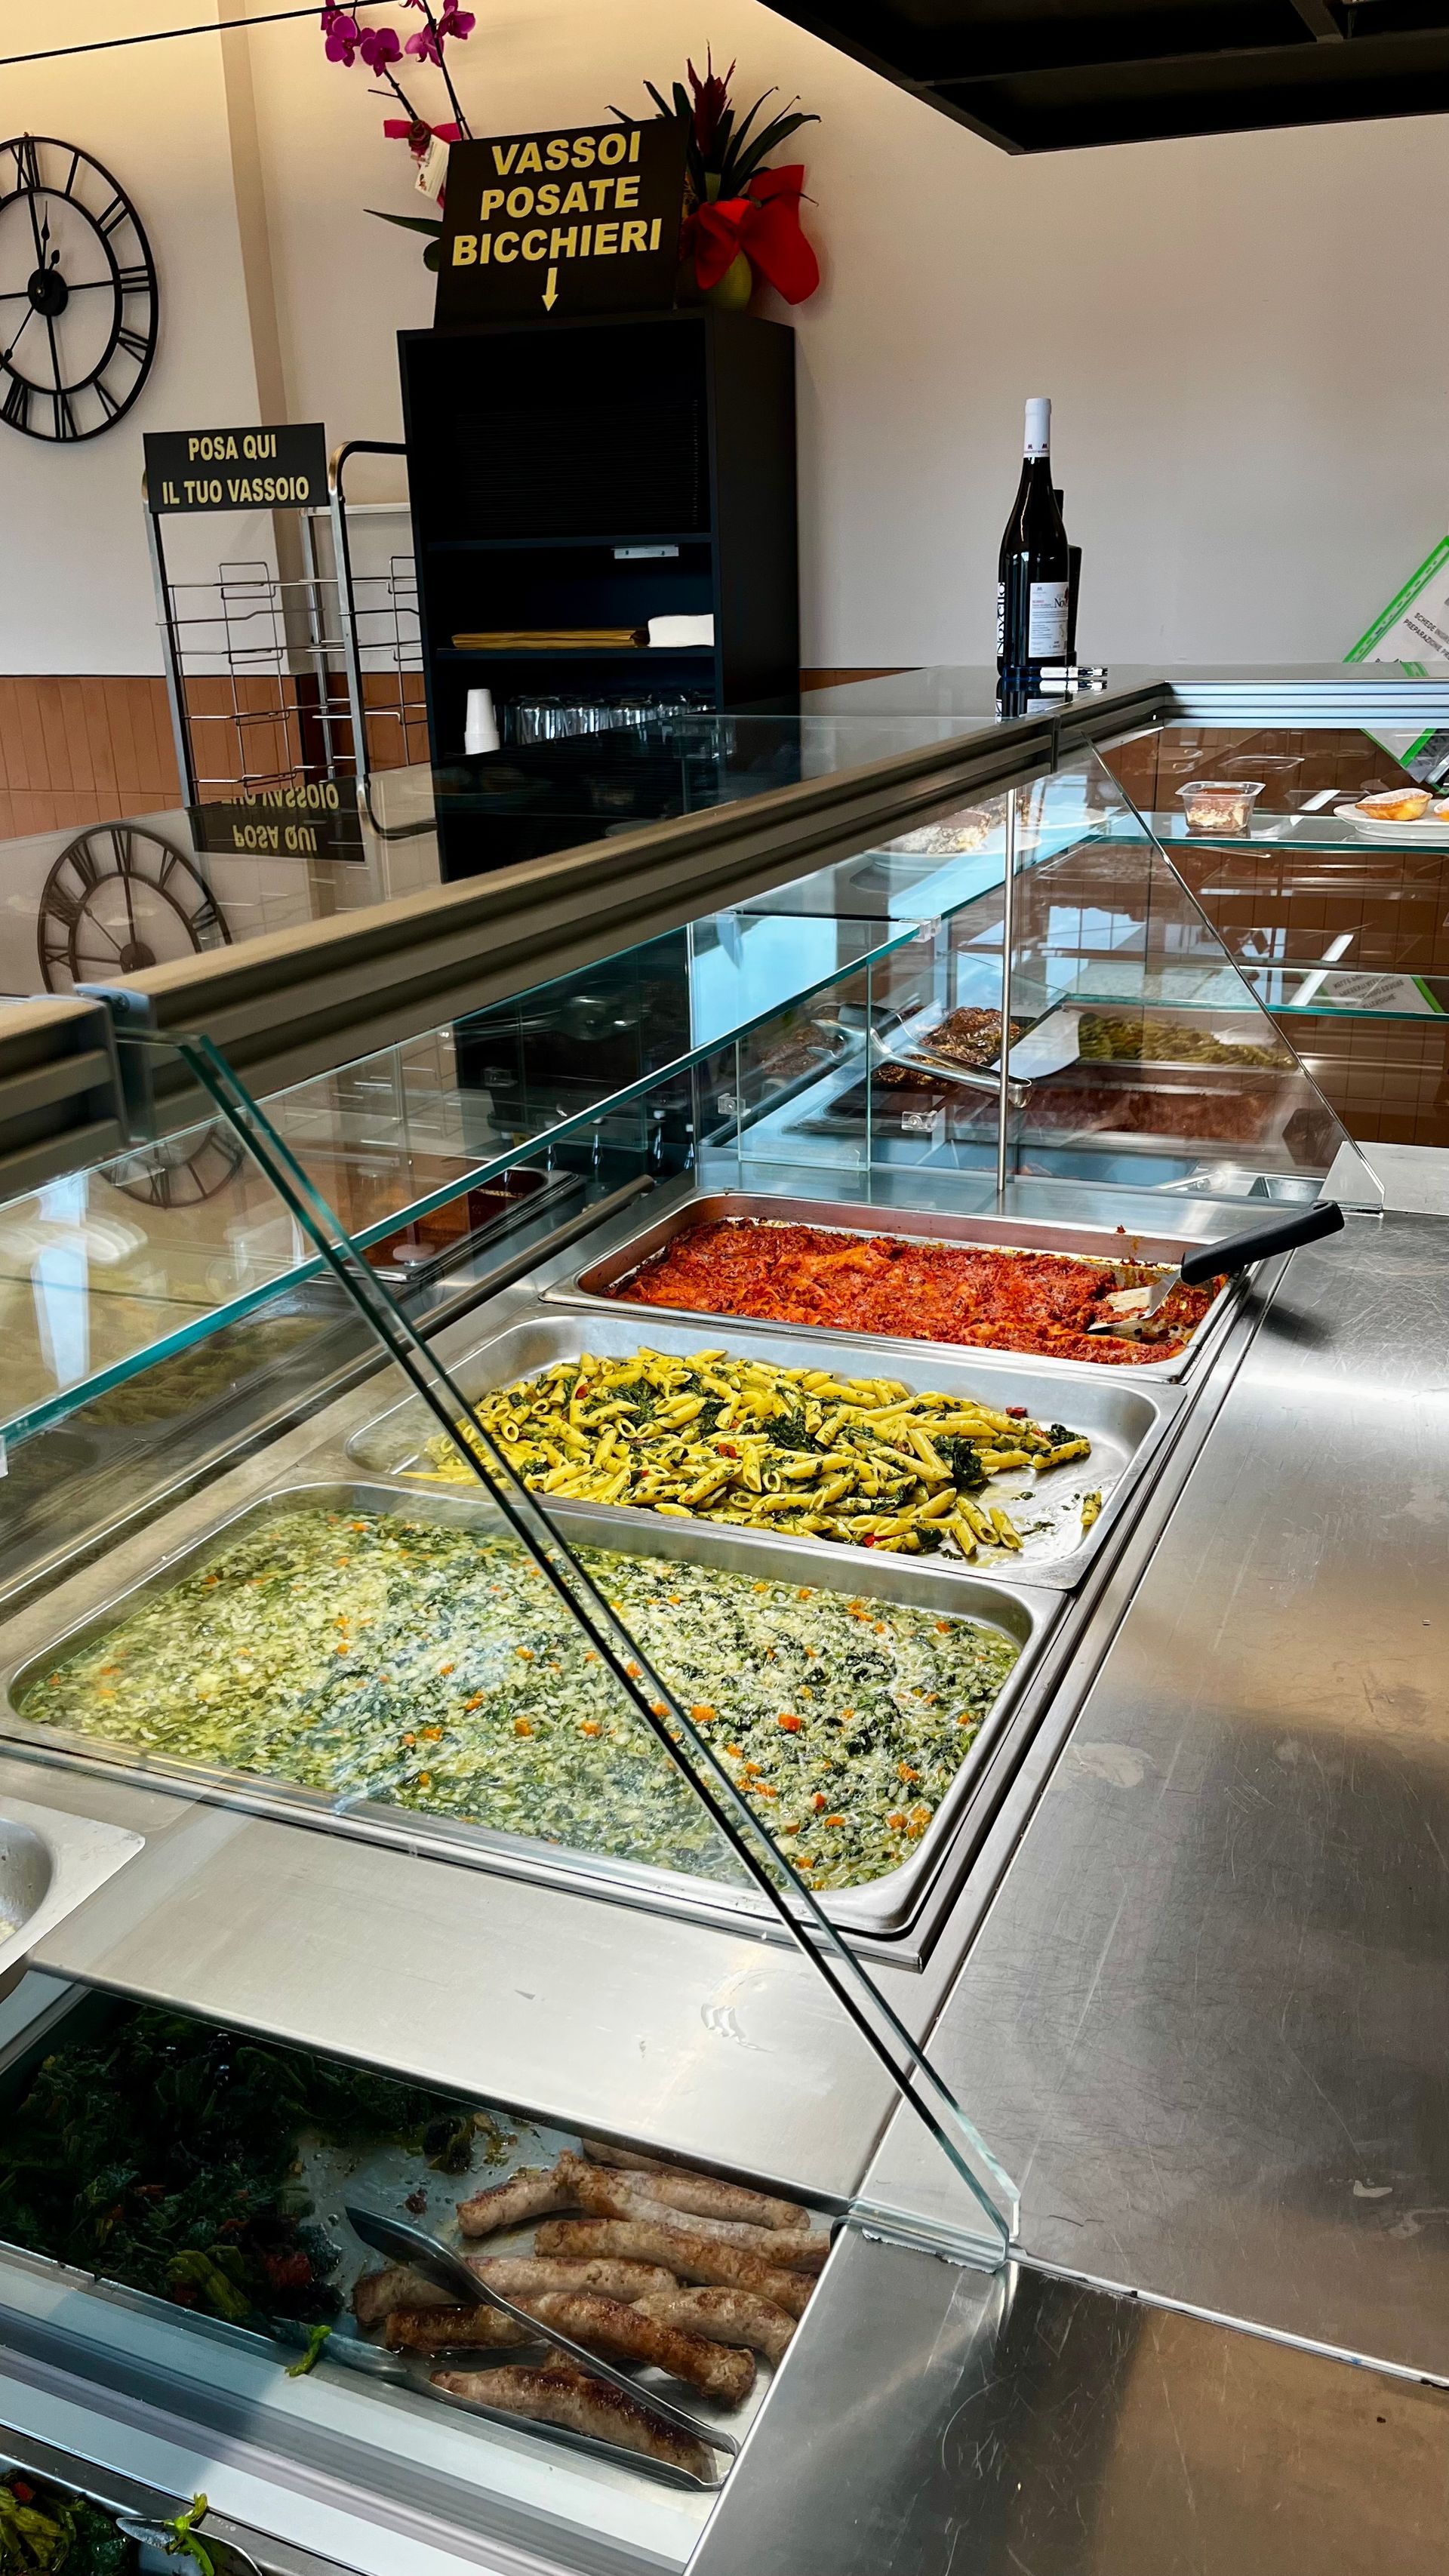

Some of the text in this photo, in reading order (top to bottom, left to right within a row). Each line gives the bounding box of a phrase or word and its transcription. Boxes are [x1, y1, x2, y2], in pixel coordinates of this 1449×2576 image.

[492, 131, 640, 175] VASSOI
[480, 176, 640, 220] POSATE
[452, 218, 661, 266] BICCHIERI
[189, 434, 277, 462] POSA QUI
[162, 476, 310, 505] IL TUO VASSOIO
[996, 582, 1005, 657] Novello
[1403, 618, 1443, 652] PREPARAZIONE
[1414, 612, 1437, 632] SCHEDE
